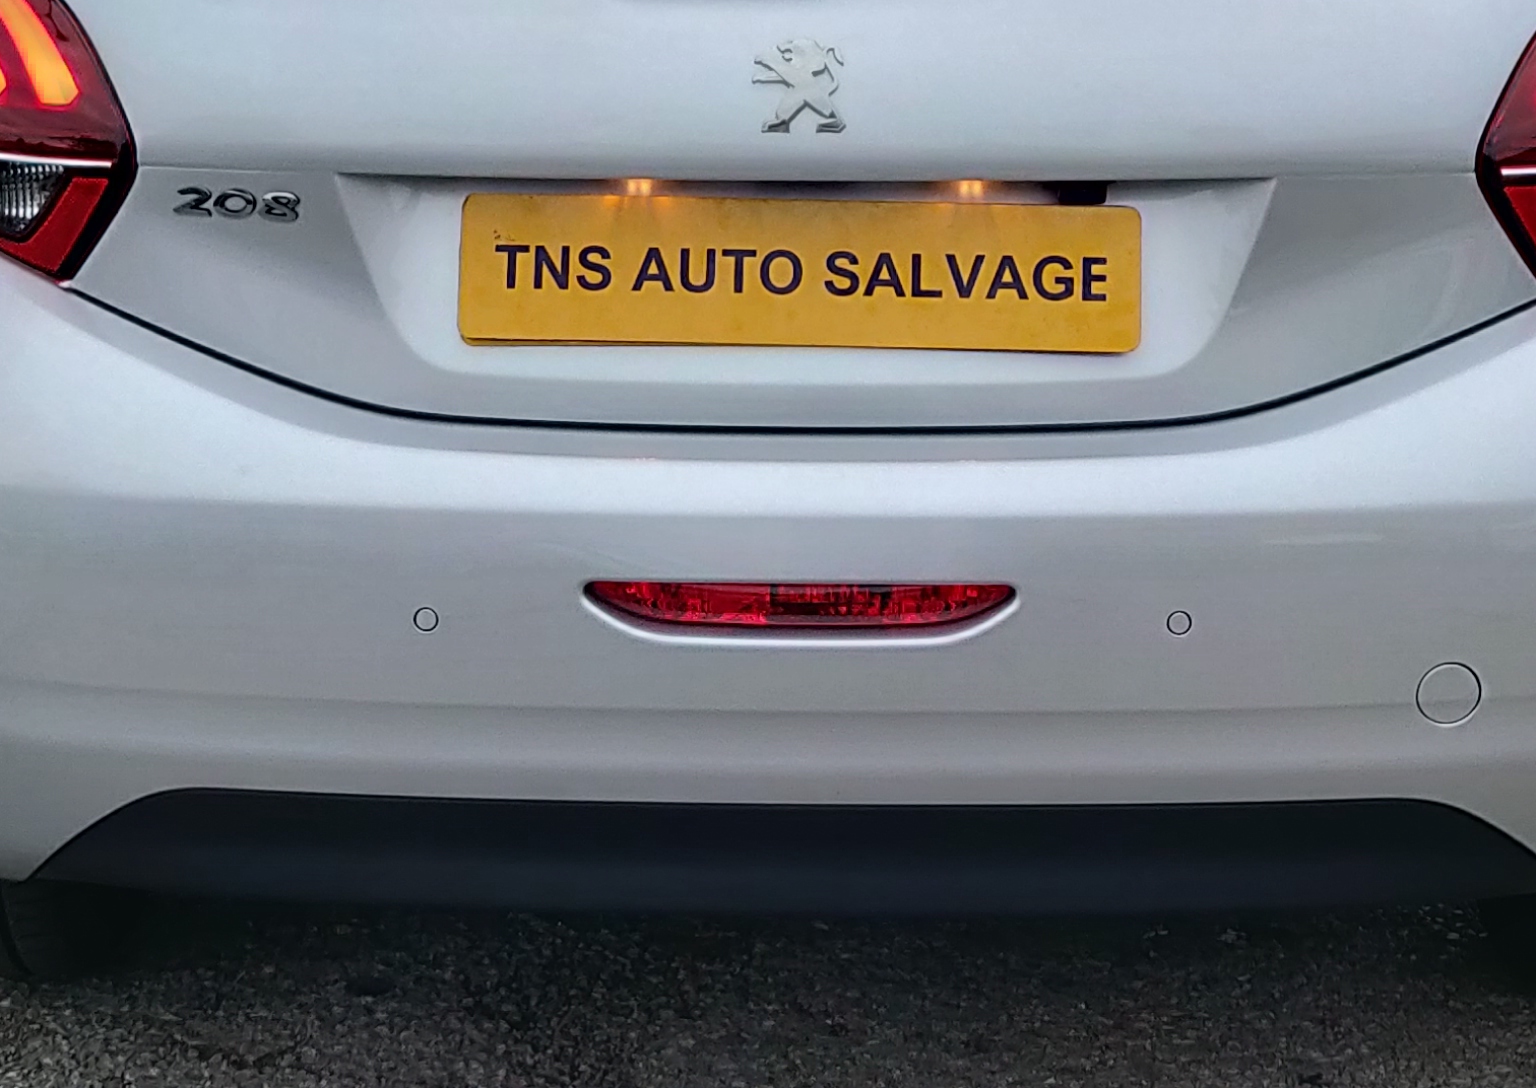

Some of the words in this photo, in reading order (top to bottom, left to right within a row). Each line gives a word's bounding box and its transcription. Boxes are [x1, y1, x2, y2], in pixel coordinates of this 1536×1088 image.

[172, 186, 301, 224] 208
[495, 244, 612, 291] TNS
[631, 247, 803, 295] AUTO
[824, 250, 1108, 302] SALVAGE
